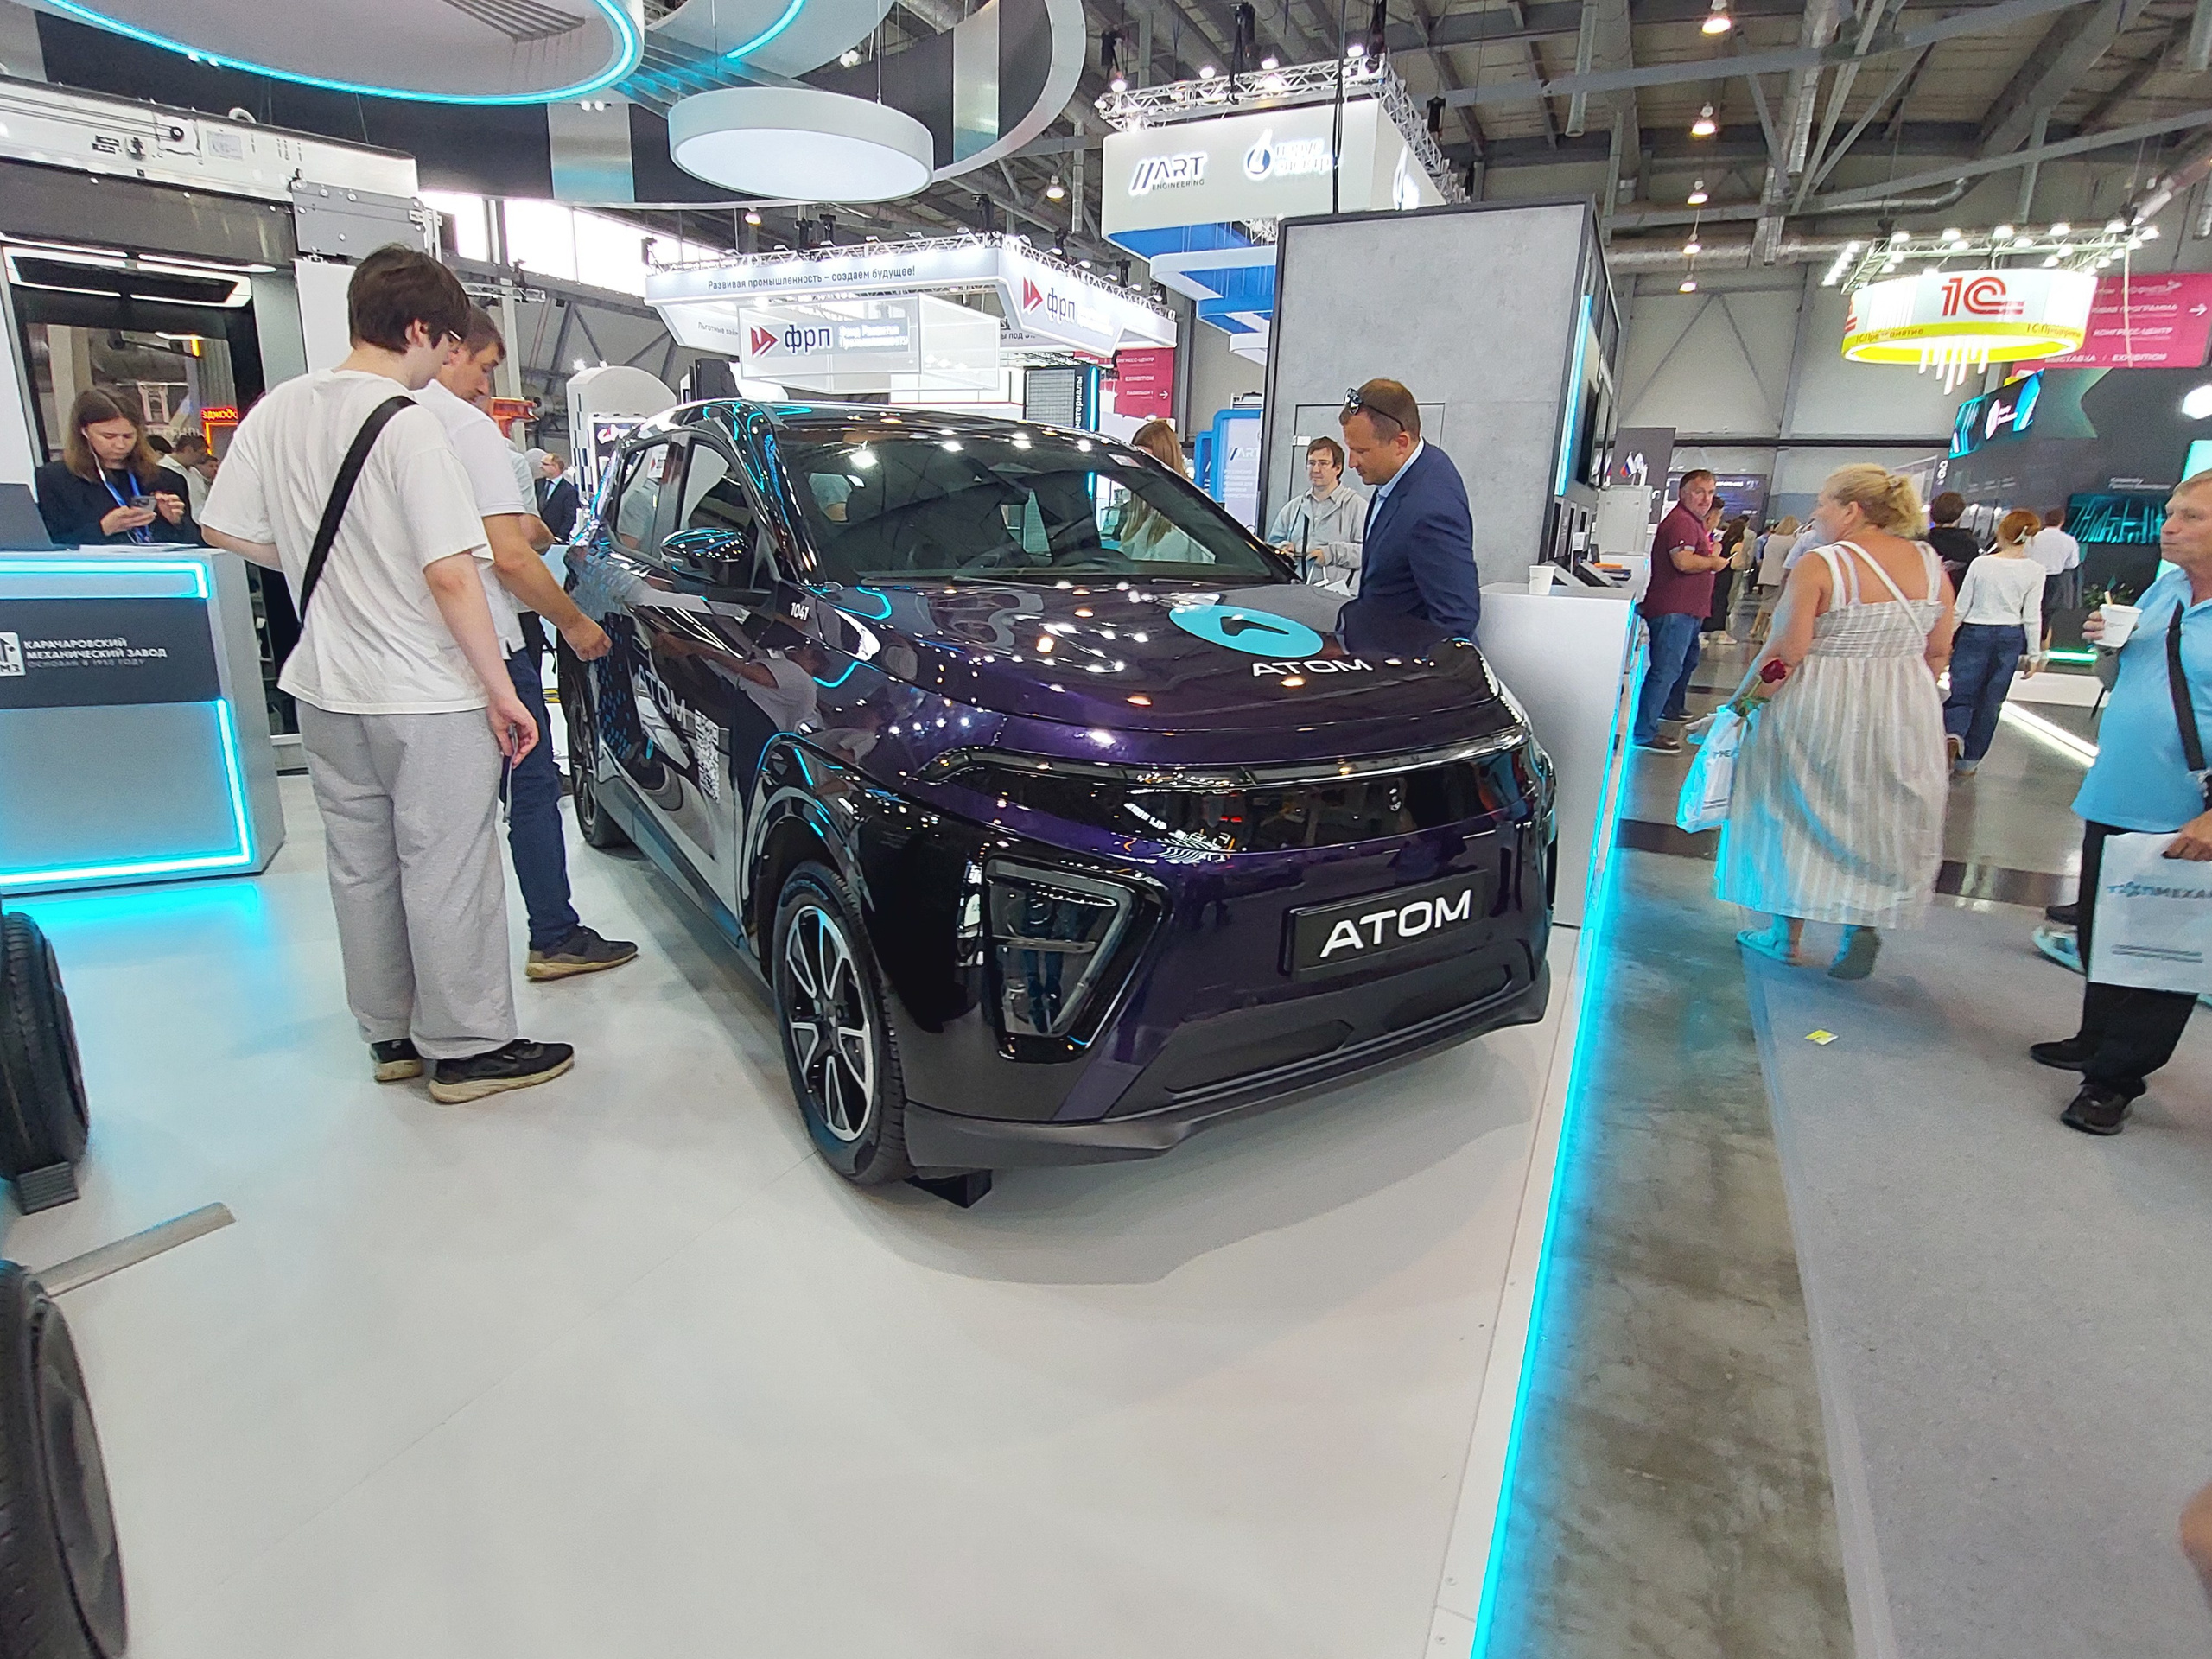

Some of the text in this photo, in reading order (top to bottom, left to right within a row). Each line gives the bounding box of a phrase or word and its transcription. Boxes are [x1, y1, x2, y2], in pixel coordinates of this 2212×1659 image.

[1152, 179, 1205, 191] ENGINEERING
[708, 280, 747, 290] Развивая
[747, 275, 823, 289] промышленность
[831, 270, 870, 283] создаем
[872, 265, 916, 279] будущее!
[1047, 287, 1075, 319] фрп
[784, 324, 831, 354] фрп
[790, 601, 810, 621] 1041
[23, 637, 128, 650] КАРАЧАРОВСКИЙ
[26, 648, 168, 659] МЕХАНИЧЕСКИЙ ЗАВОД
[1252, 658, 1374, 677] ATOM
[637, 664, 687, 730] ATOM
[1319, 888, 1471, 958] ATOM
